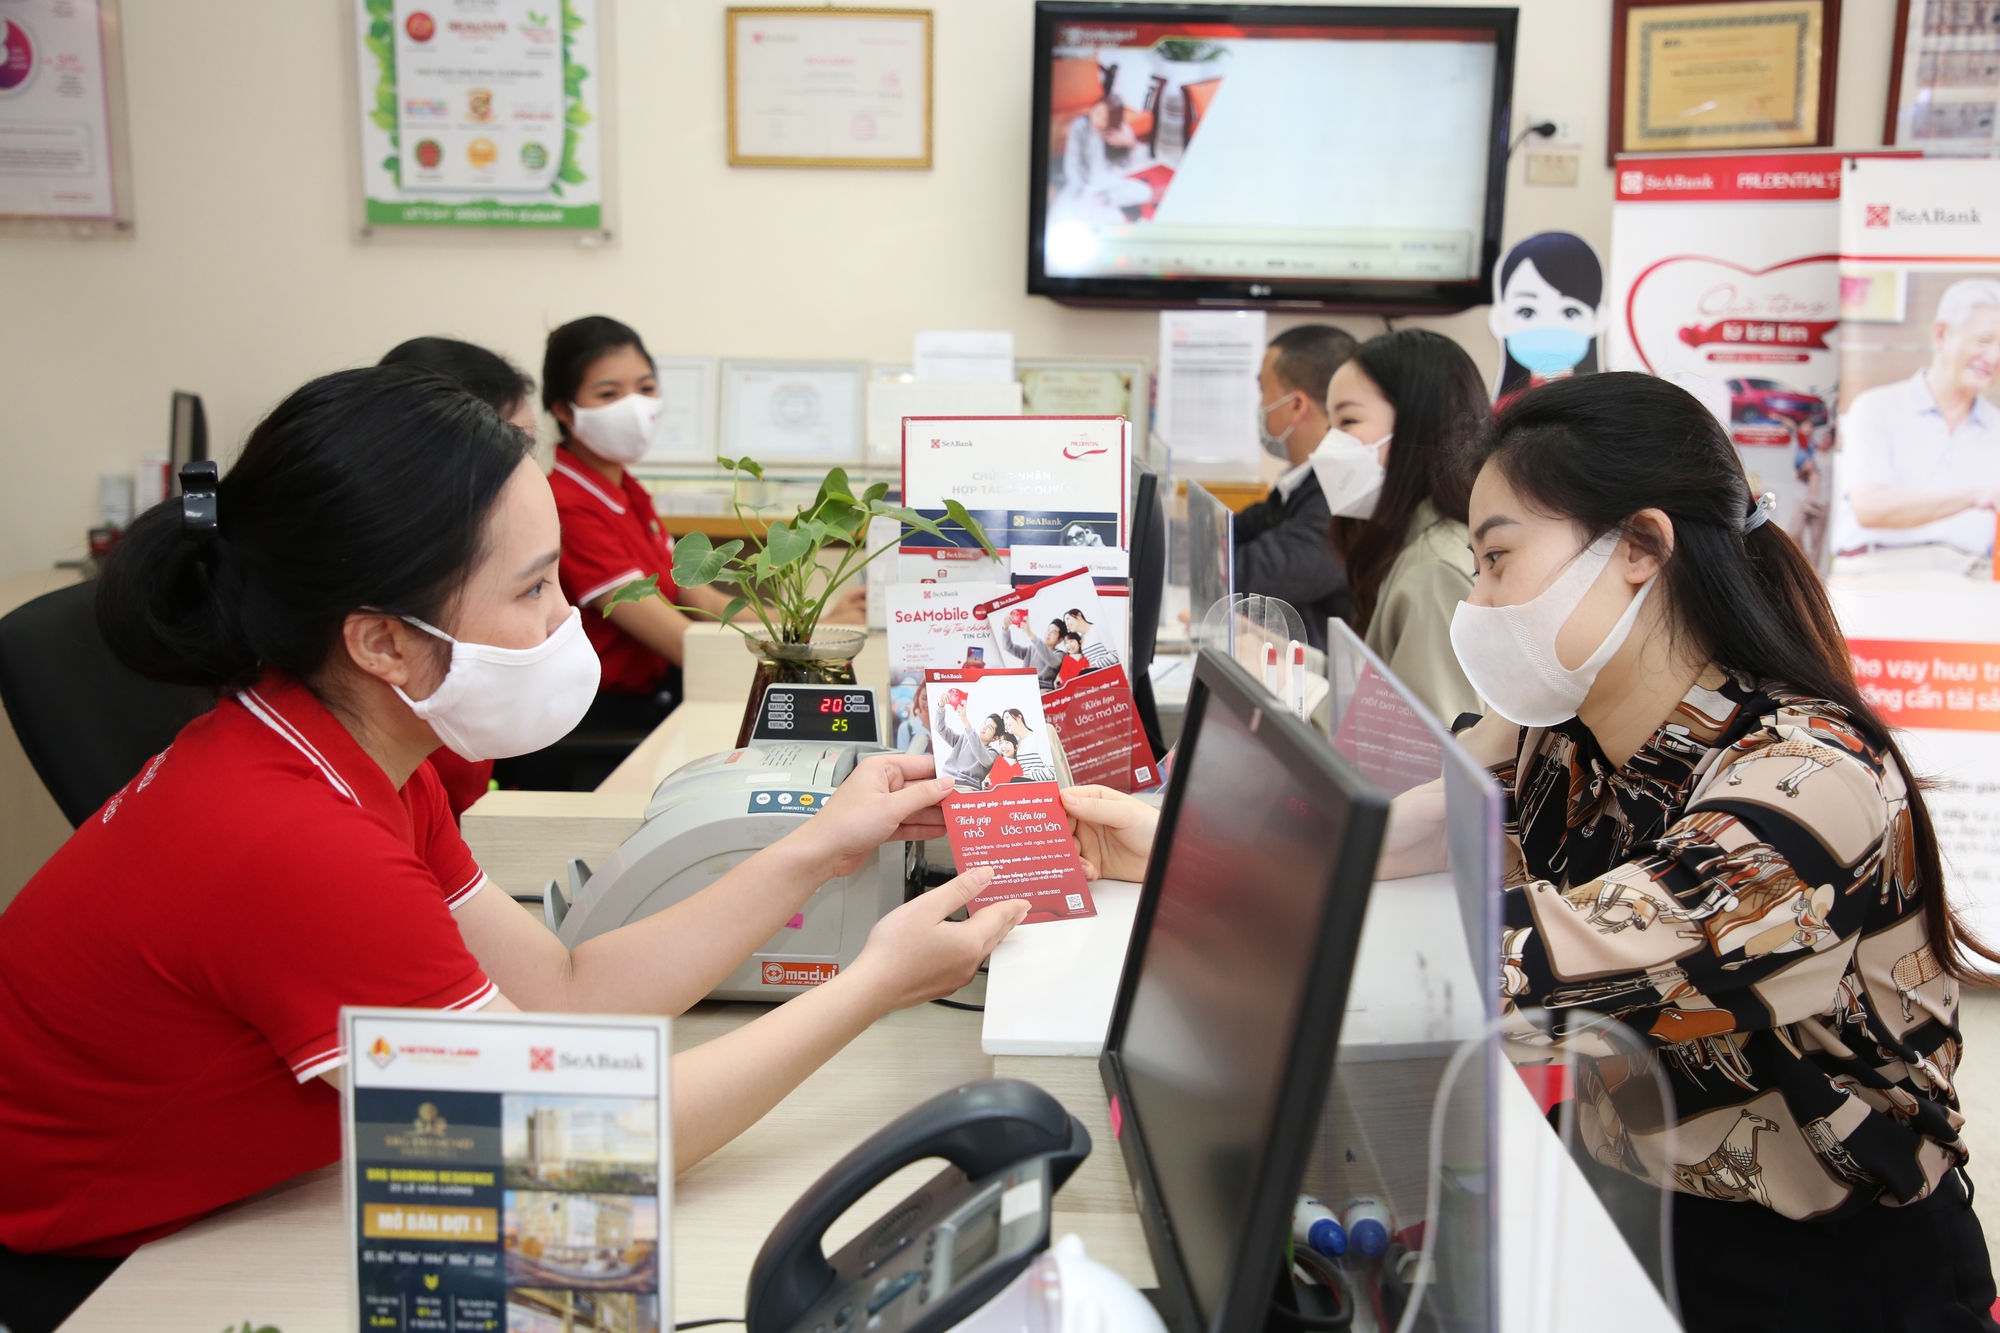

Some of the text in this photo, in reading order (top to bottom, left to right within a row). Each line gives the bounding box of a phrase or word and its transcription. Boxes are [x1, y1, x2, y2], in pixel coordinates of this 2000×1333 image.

[1645, 173, 1714, 190] SeABank
[1737, 172, 1827, 190] PRUDENTIAL
[1895, 205, 1982, 225] SeABank
[941, 440, 974, 448] SeABank
[1018, 469, 1051, 483] NHẬN
[952, 485, 978, 496] HỢP
[1025, 517, 1062, 527] SeABank
[946, 551, 975, 559] SeABank
[932, 590, 959, 598] SeABank
[999, 595, 1021, 606] SeABank
[895, 607, 969, 623] SeAMobile
[940, 672, 963, 680] SeABank
[1850, 654, 1882, 678] ho
[1886, 659, 1929, 684] vay
[1983, 661, 2000, 682] tr
[1860, 683, 1903, 712] ông
[1905, 682, 1944, 709] cần
[1946, 686, 1975, 711] tài
[820, 698, 843, 712] 20
[1074, 702, 1129, 726] Ước mơ lớn
[832, 719, 848, 732] 25
[976, 815, 992, 826] góp
[1033, 811, 1047, 821] tạo
[963, 827, 985, 838] nhỏ
[1000, 822, 1062, 836] Ước mơ lớn
[559, 1051, 646, 1071] SeABank
[389, 1168, 437, 1183] DIAMOND
[377, 1207, 483, 1236] MỞ BÁN ĐỢT 1
